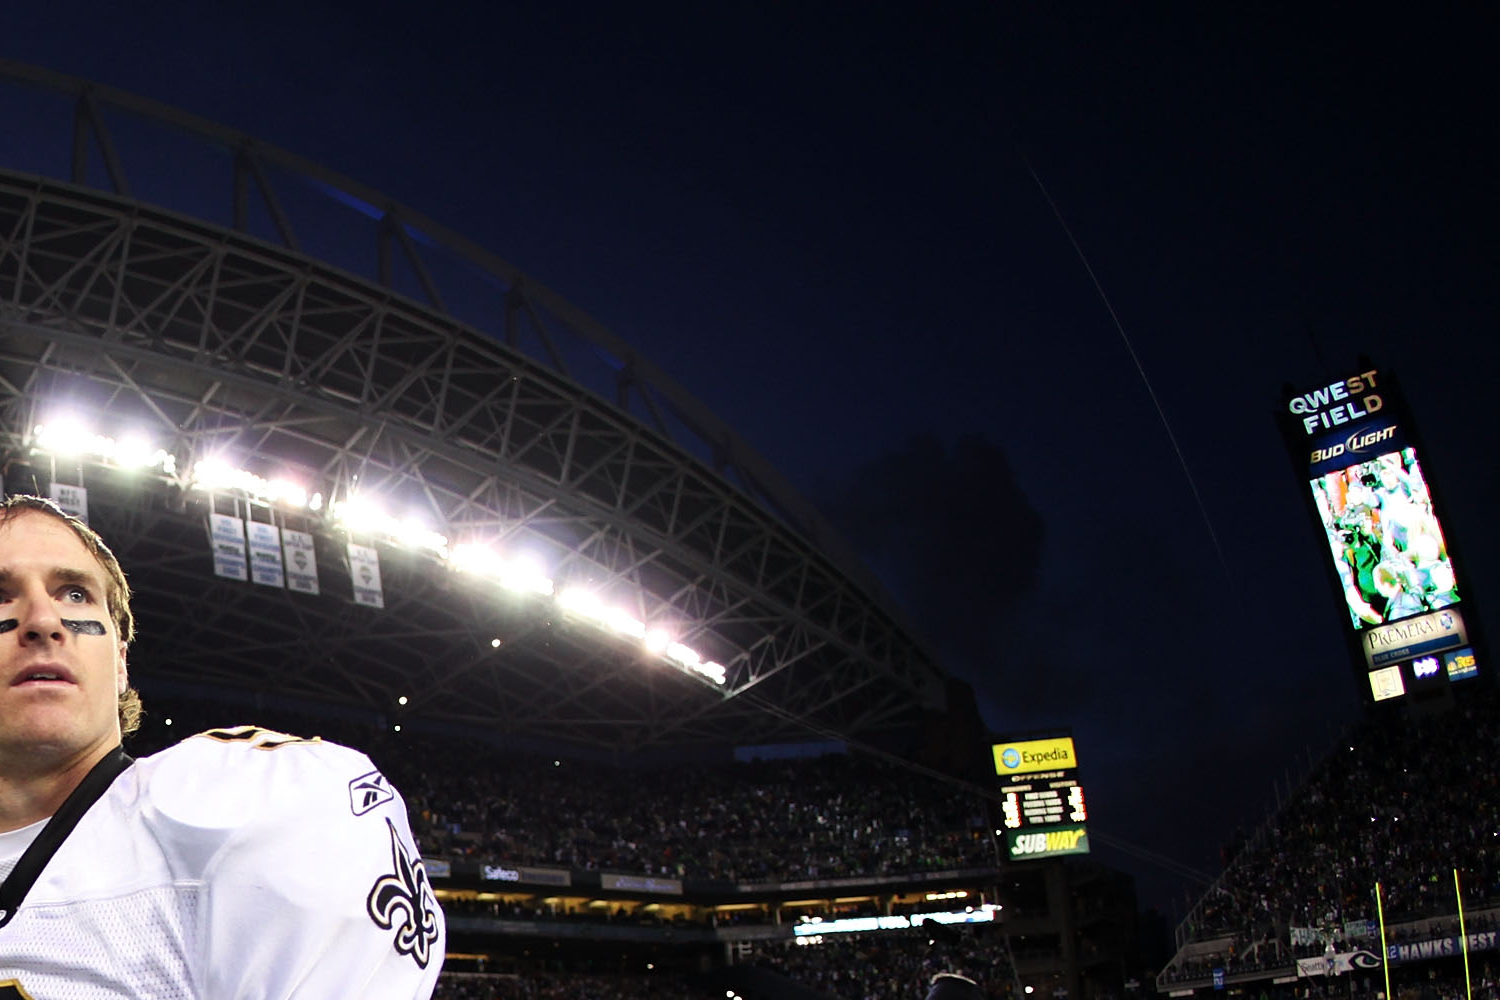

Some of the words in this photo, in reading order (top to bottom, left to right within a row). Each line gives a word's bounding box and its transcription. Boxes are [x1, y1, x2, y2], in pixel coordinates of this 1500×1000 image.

[1289, 370, 1377, 414] QWEST
[1303, 395, 1382, 435] FIELD
[1311, 443, 1344, 463] BUD
[1352, 426, 1396, 450] LIGHT
[1368, 620, 1434, 649] PREMERA
[1022, 748, 1068, 765] Expedia
[1011, 829, 1086, 855] SUBWAY
[1400, 938, 1453, 960] HAWKS
